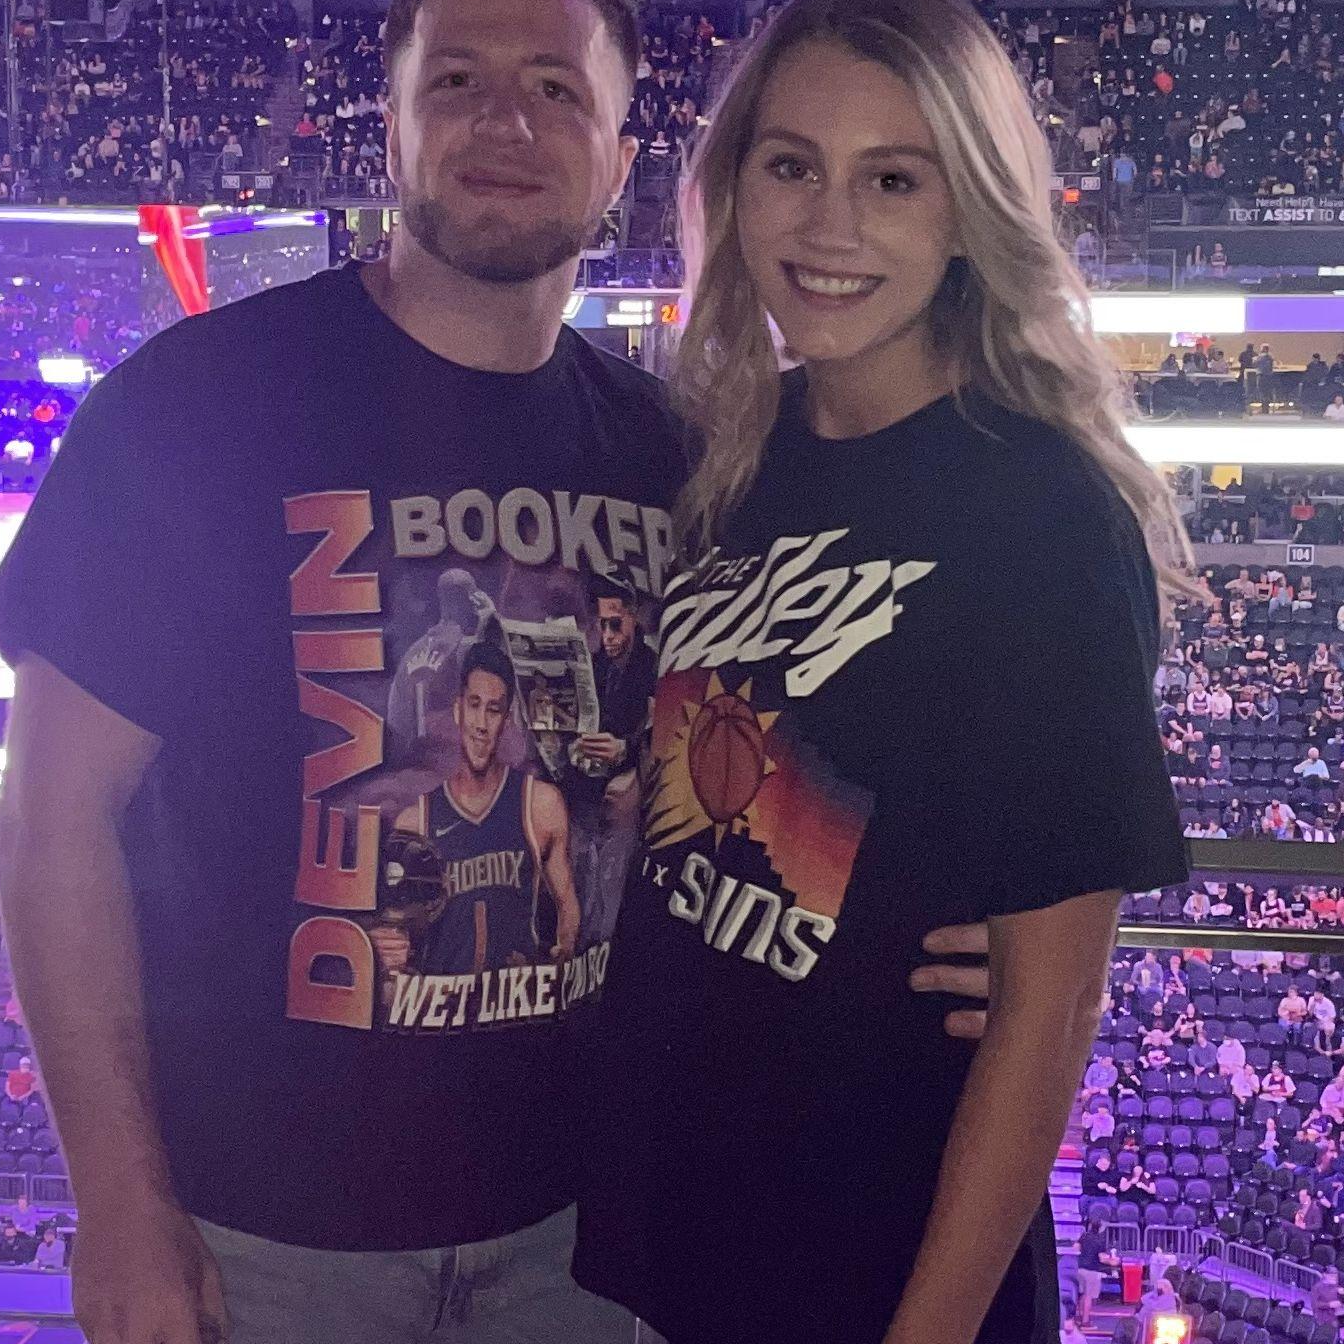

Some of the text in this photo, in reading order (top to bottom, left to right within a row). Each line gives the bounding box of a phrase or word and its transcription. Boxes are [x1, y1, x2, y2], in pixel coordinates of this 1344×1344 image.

[1228, 208, 1261, 222] TEXT
[1262, 208, 1315, 223] ASSIST
[1318, 208, 1335, 222] TO
[1291, 548, 1310, 561] 104
[282, 489, 386, 1031] DEVIN
[388, 969, 476, 1027] WET
[477, 964, 557, 1024] LIKE
